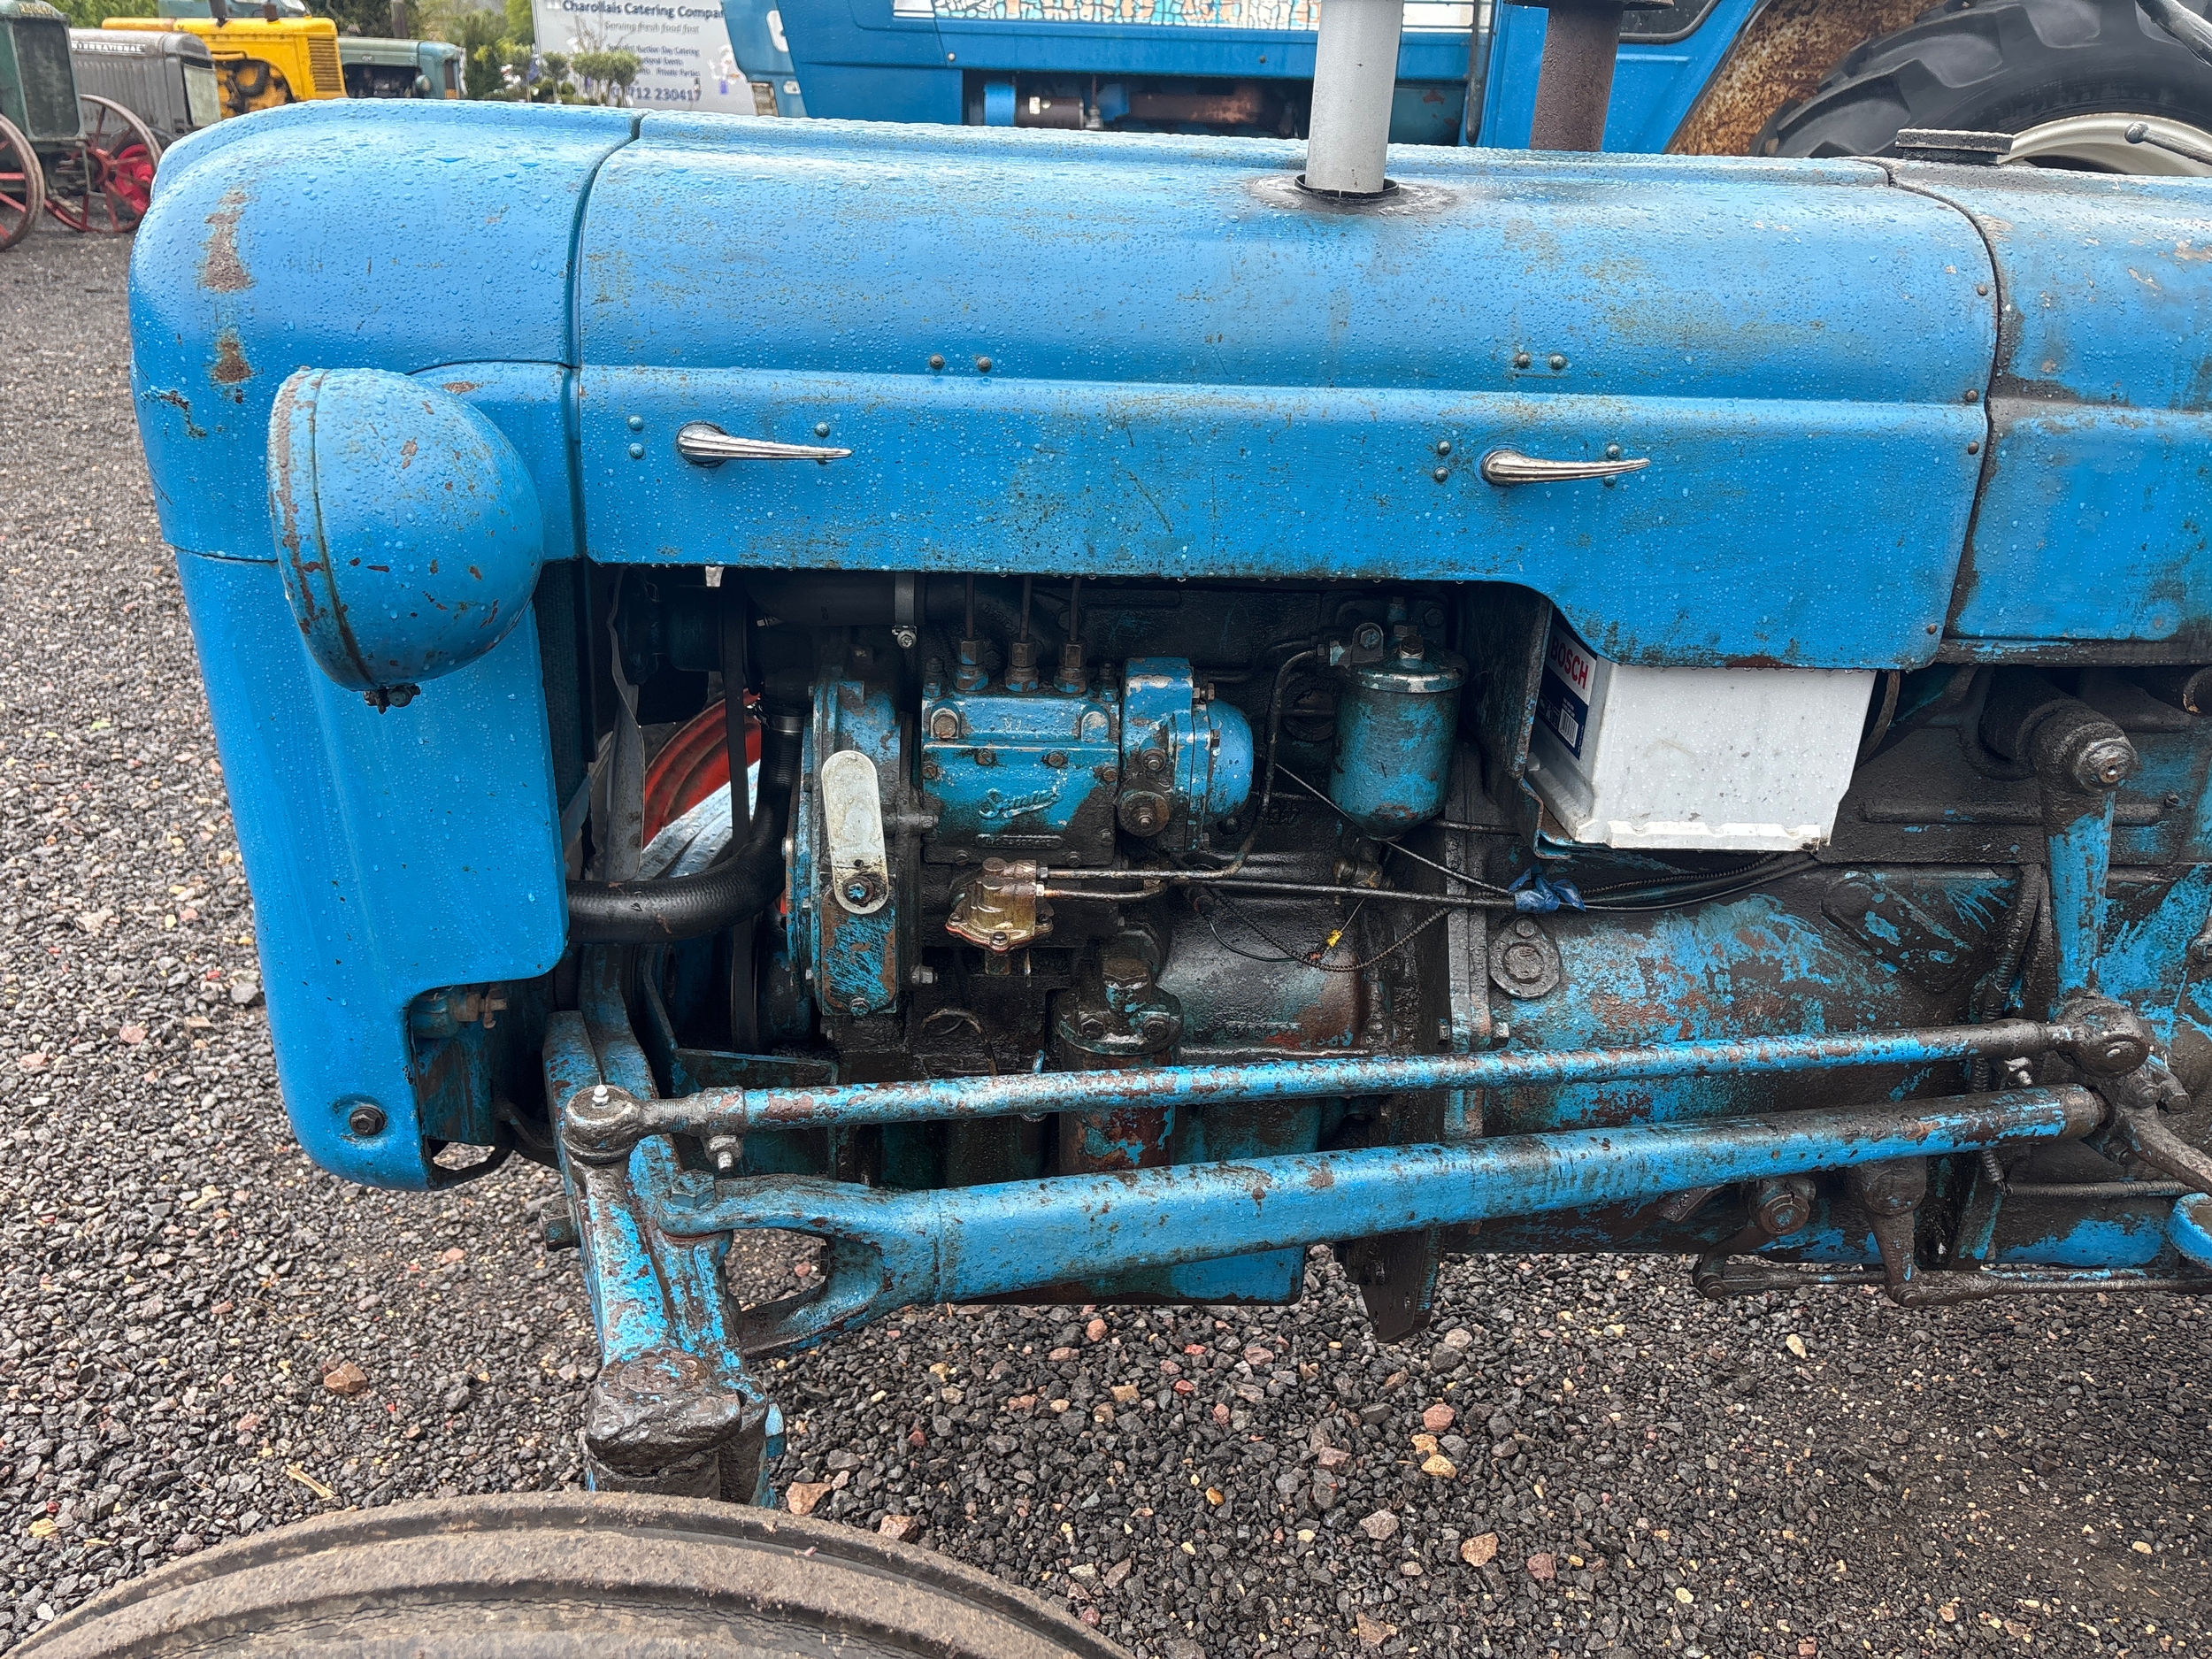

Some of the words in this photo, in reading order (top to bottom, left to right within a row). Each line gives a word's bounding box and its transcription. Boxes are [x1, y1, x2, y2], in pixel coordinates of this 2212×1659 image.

[563, 0, 622, 14] Charollais
[625, 3, 675, 19] Catering
[603, 20, 636, 33] Serving
[637, 21, 660, 34] fresh
[661, 22, 681, 34] food
[71, 42, 142, 52] NTERNATIONAL
[662, 46, 673, 55] Day
[674, 47, 700, 58] Catering
[664, 57, 684, 65] Events
[656, 67, 678, 76] Private
[654, 88, 702, 102] 230417
[1550, 634, 1589, 690] BOSCH
